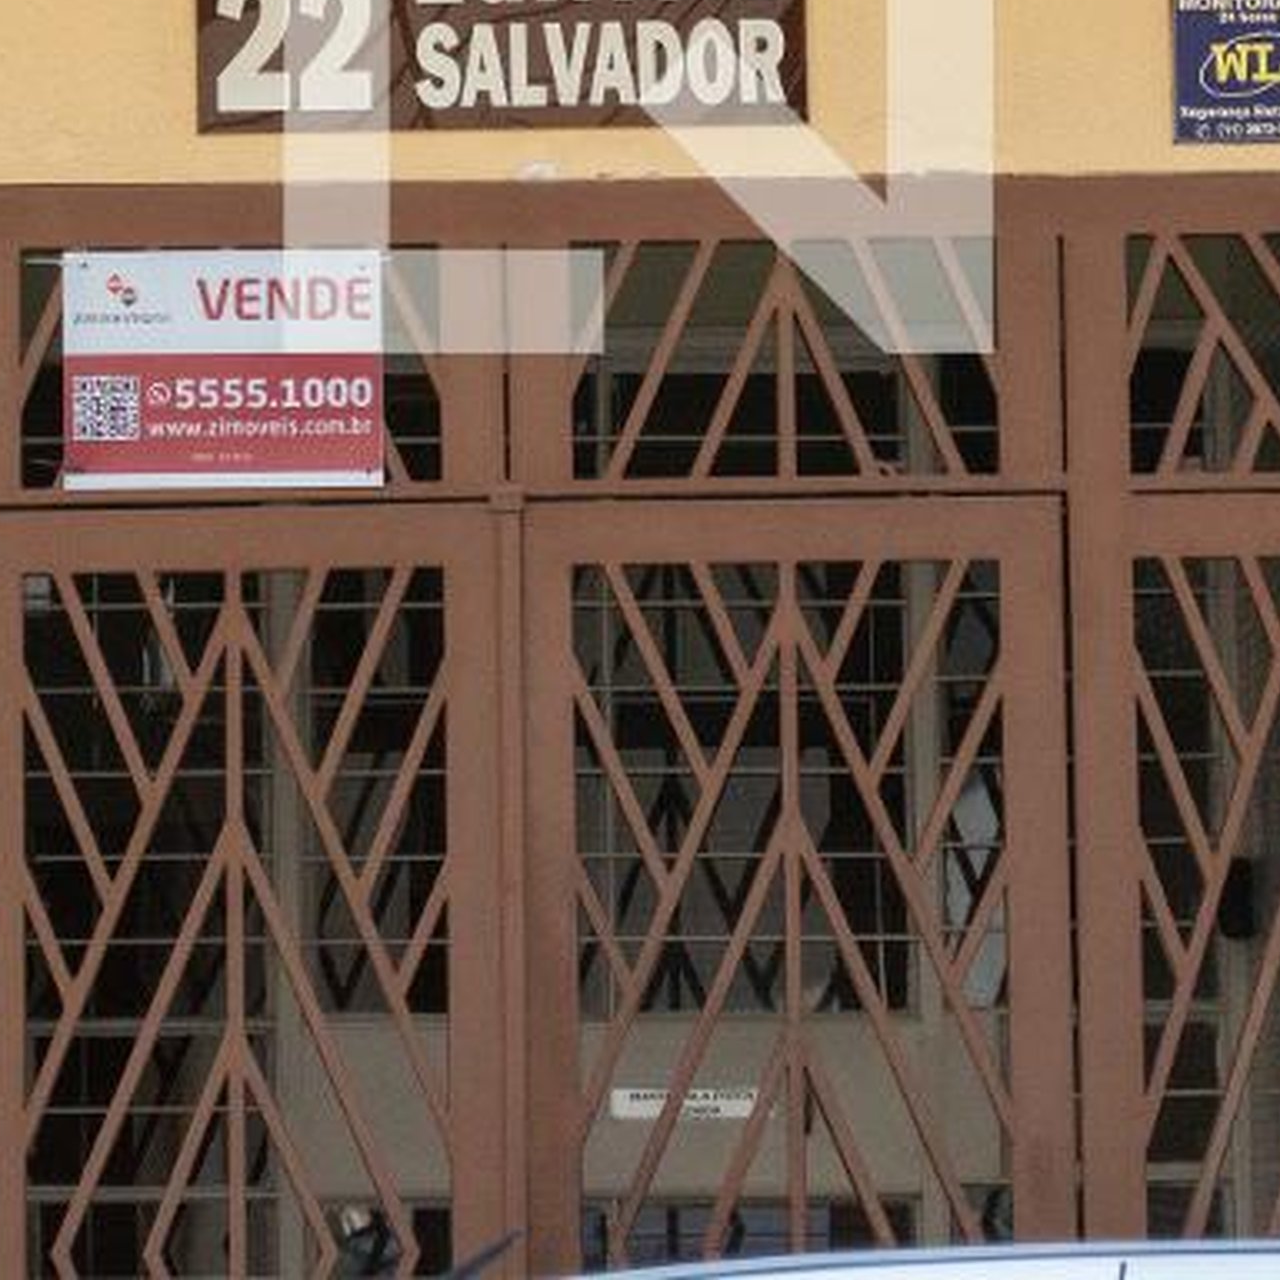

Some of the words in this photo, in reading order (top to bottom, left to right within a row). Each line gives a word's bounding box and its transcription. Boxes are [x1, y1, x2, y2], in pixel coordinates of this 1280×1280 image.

[415, 18, 787, 109] SALVADOR
[196, 277, 373, 321] VENDE
[175, 378, 373, 410] 5555.1000
